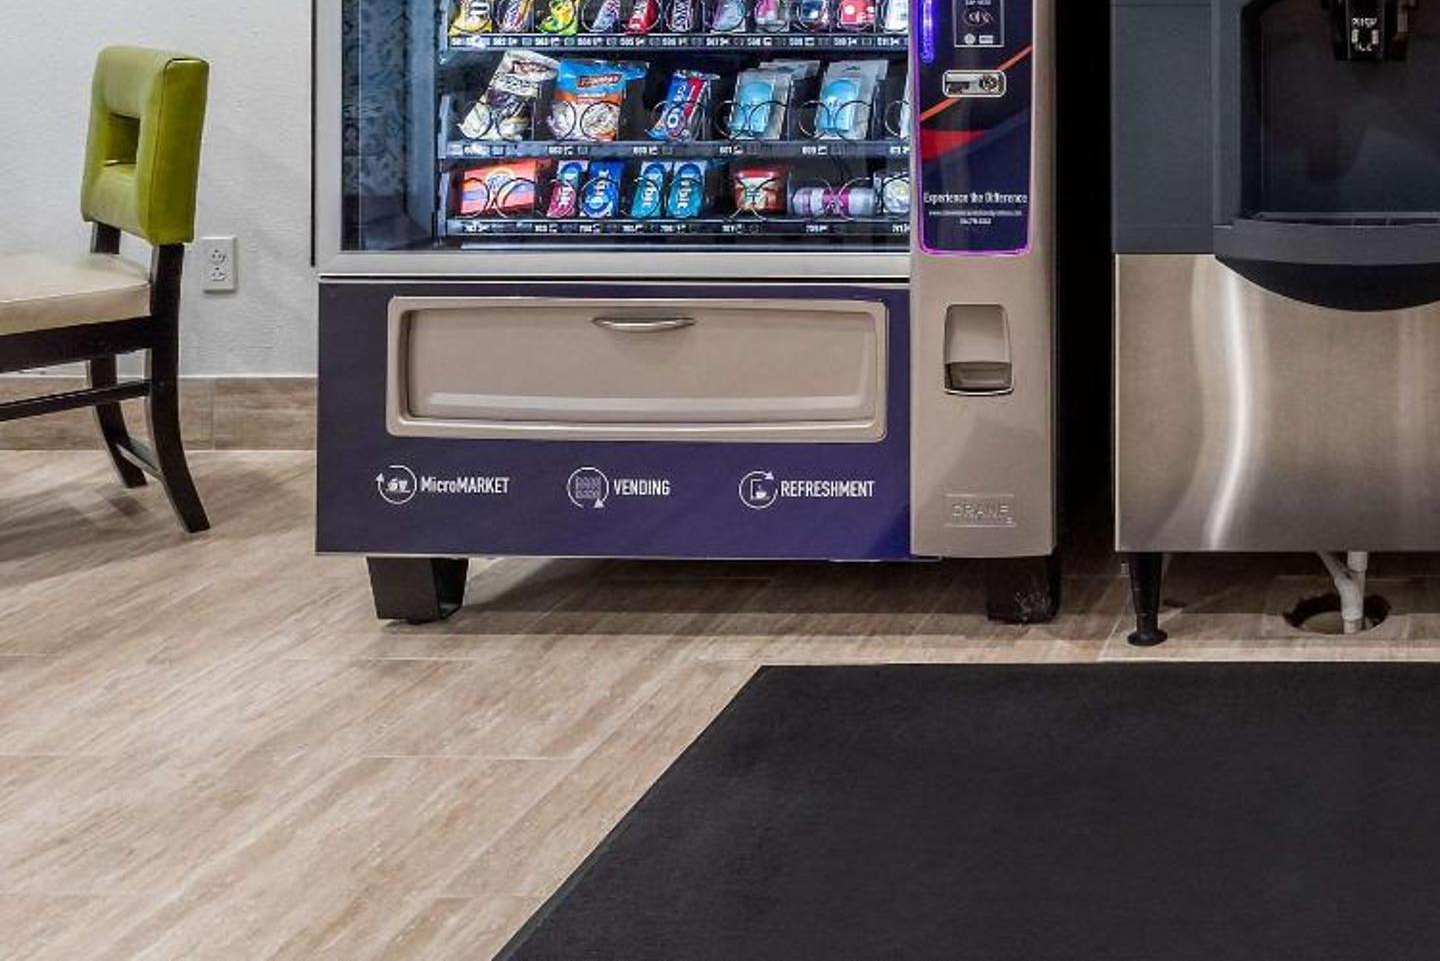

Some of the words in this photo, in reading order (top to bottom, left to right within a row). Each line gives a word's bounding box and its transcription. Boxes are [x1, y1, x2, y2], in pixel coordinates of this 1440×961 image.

[923, 192, 969, 205] Experience
[421, 476, 511, 494] MicroMARKET
[614, 479, 671, 496] VENDING
[780, 480, 876, 498] REFRESHMENT
